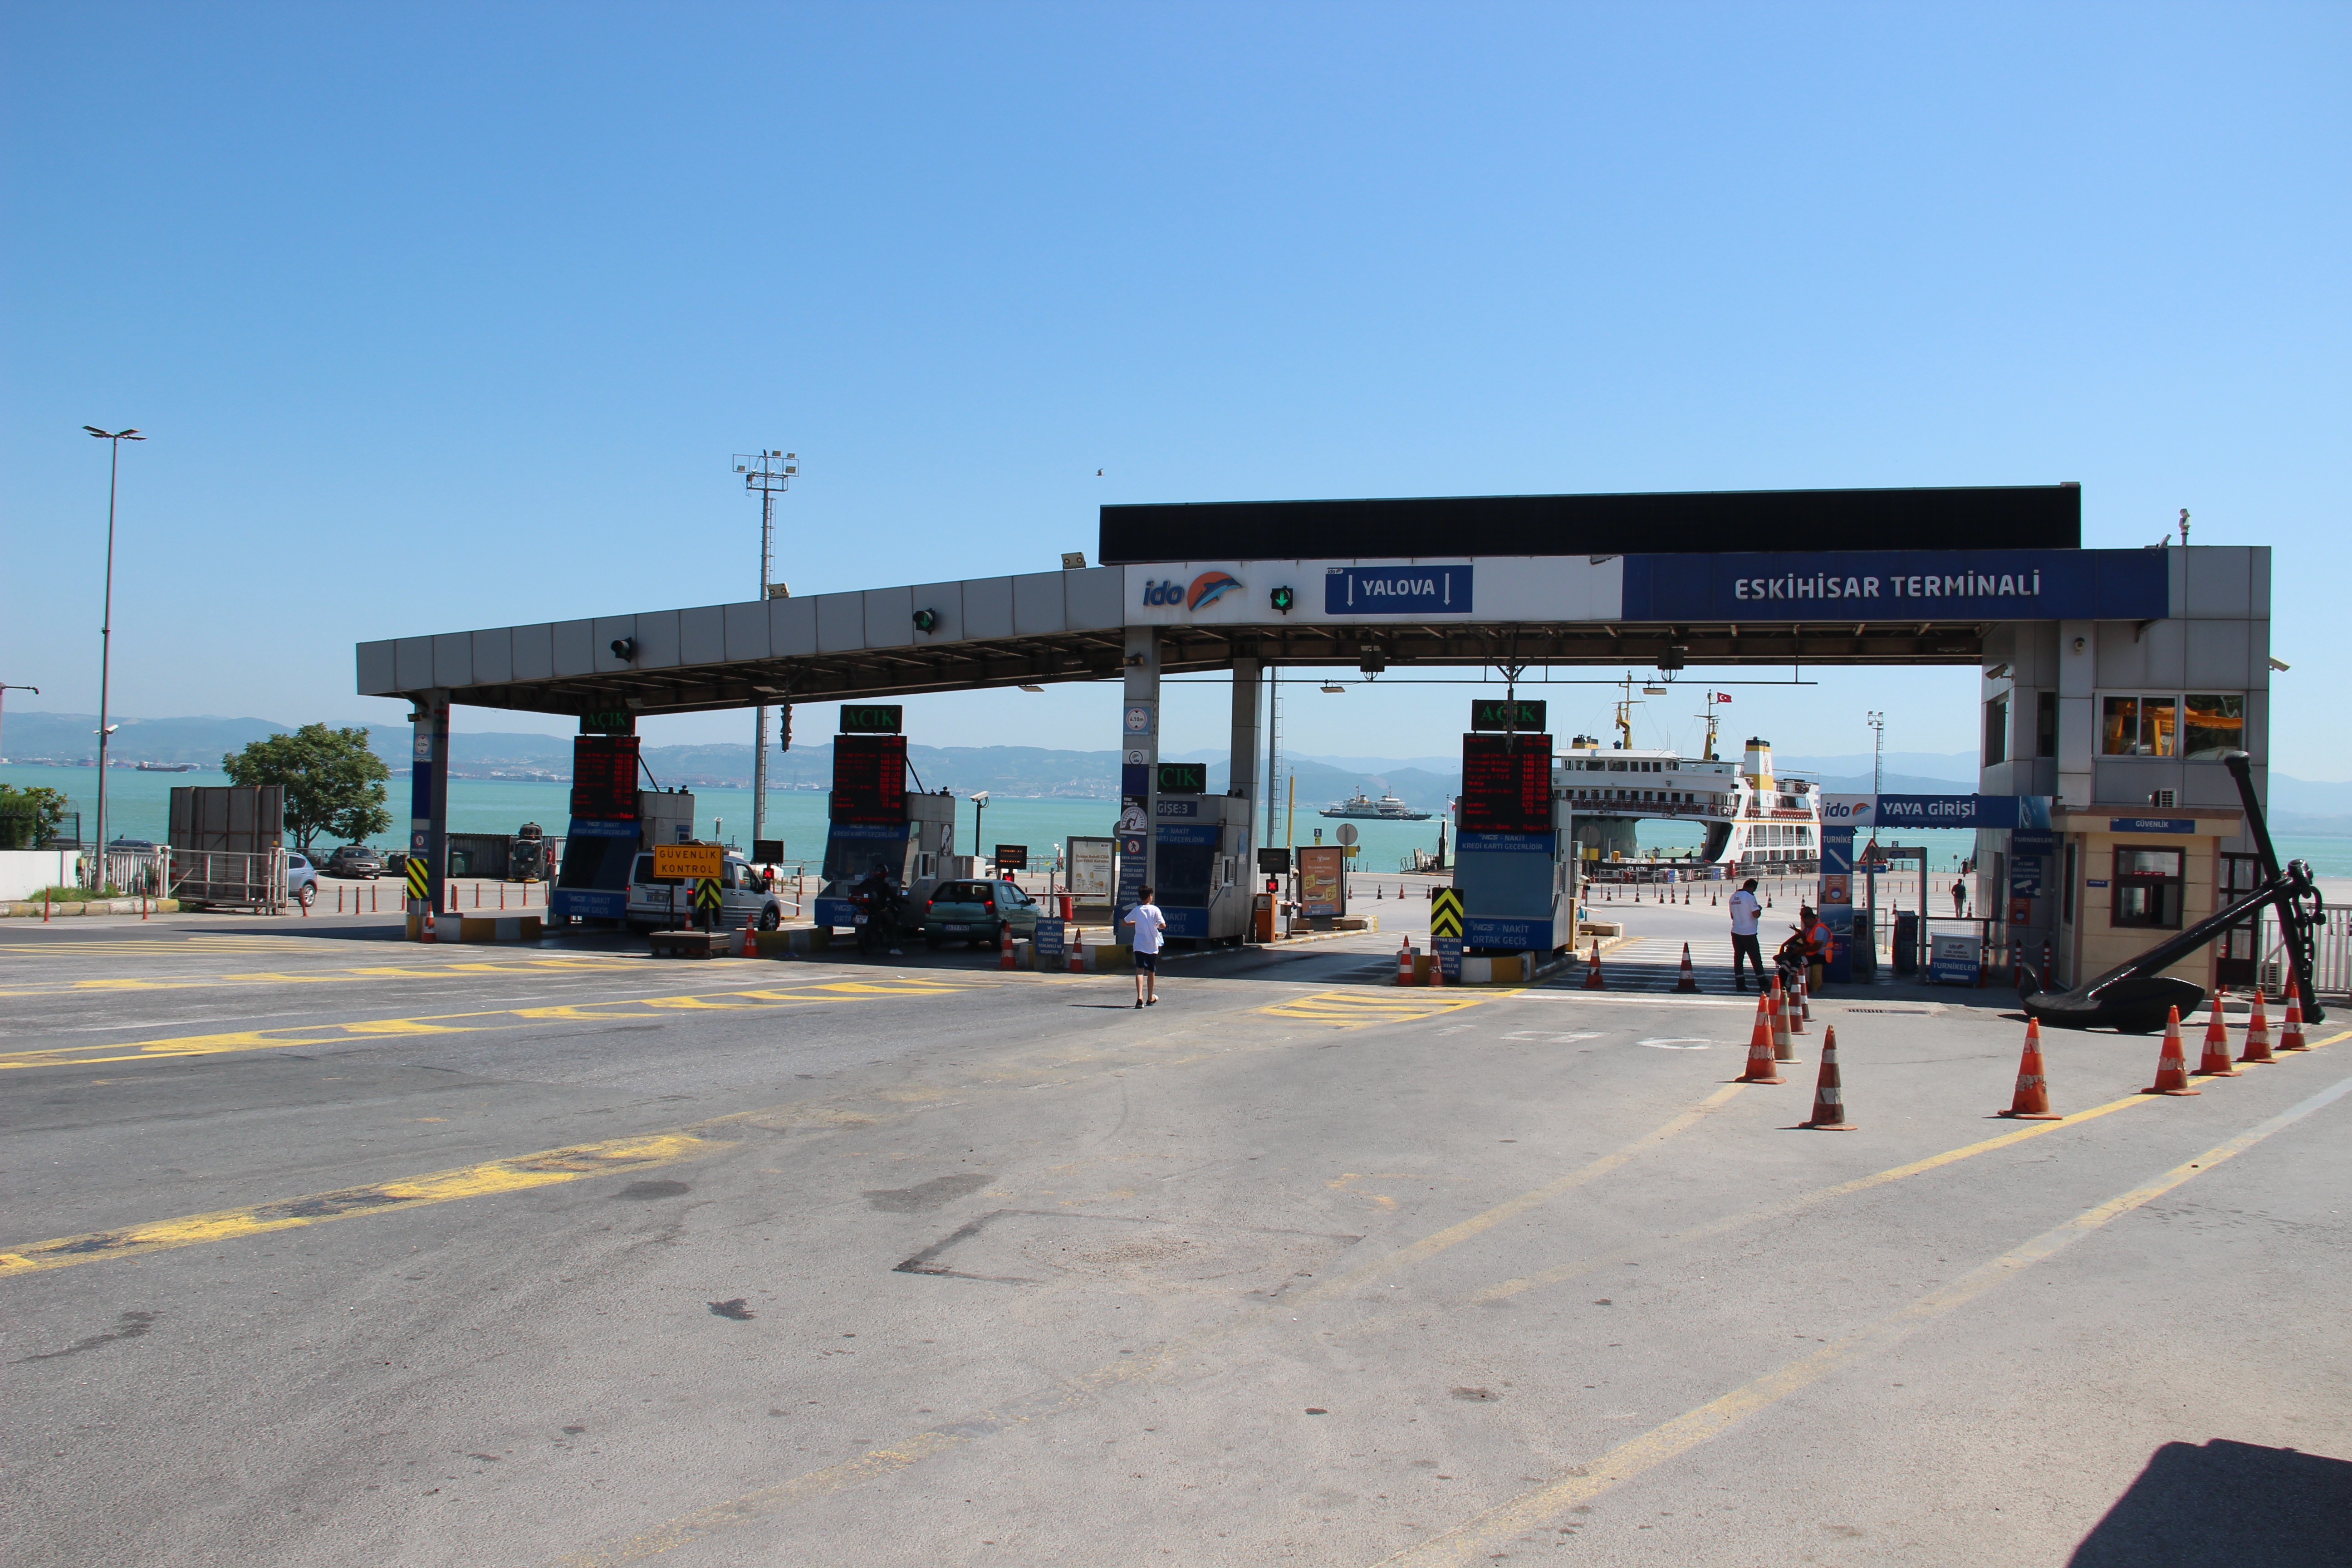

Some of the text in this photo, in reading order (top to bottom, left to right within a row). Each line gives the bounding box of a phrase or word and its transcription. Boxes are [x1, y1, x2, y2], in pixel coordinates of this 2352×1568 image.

[1362, 579, 1435, 596] YALOVA
[1735, 569, 2040, 599] ESKİHİSAR TERMİNALİ
[1143, 580, 1185, 605] ido
[586, 712, 627, 729] AÇIK
[845, 709, 896, 727] AÇIK
[1479, 705, 1537, 725] AÇIK
[1160, 768, 1200, 788] ÇIK
[1157, 802, 1188, 815] GİŞE:3
[1824, 802, 1850, 817] ido
[1882, 800, 1975, 818] YAYA GİRİŞİ
[2135, 819, 2169, 828] GÜVENLİK
[1823, 835, 1852, 843] TURNİKE
[1504, 843, 1543, 851] GEÇERLİDİR
[659, 848, 716, 859] GÜVENLİK
[662, 864, 714, 873] KONTROL
[591, 906, 609, 915] GEÇİŞ
[1163, 912, 1187, 921] NAKİT
[1503, 924, 1529, 933] NAKİT
[1473, 935, 1527, 946] ORTAK GEÇİŞ
[1932, 962, 1977, 971] TURNİKELER
